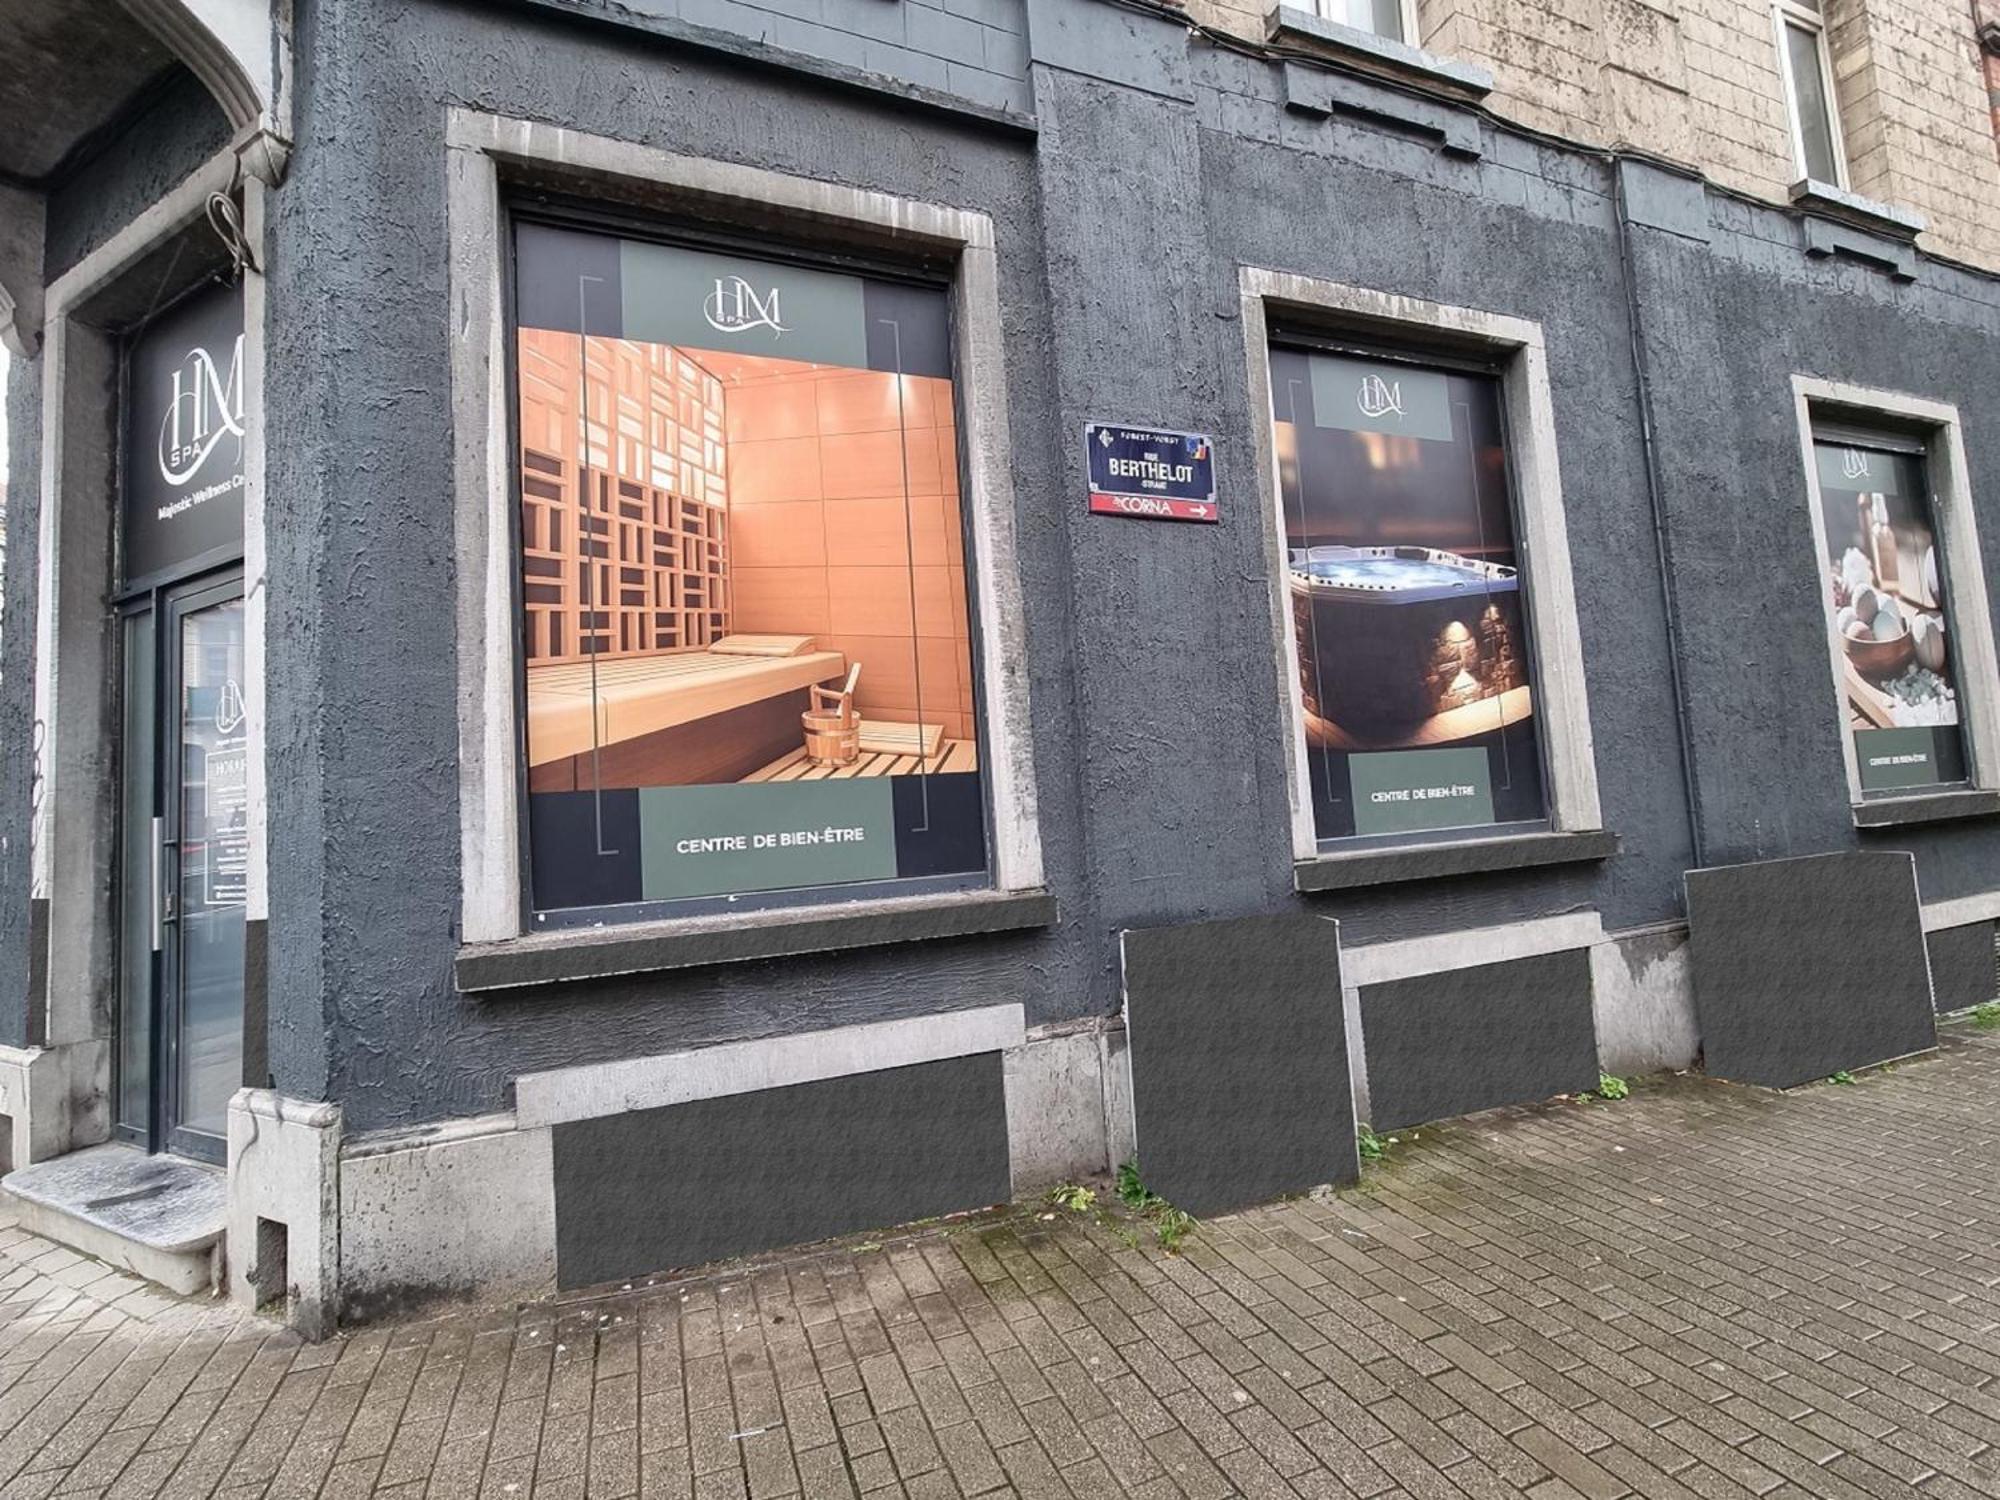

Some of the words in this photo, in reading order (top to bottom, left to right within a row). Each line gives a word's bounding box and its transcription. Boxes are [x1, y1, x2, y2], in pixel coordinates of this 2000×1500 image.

[170, 442, 202, 468] SPA
[1108, 457, 1193, 483] BERTHELOT
[158, 496, 192, 520] Majestic
[192, 480, 232, 504] Wellness
[1371, 789, 1411, 802] CENTRE
[1412, 788, 1426, 800] DE
[676, 835, 747, 854] CENTRE
[753, 833, 777, 849] DE
[780, 826, 865, 847] BIEN-ÊTRE
